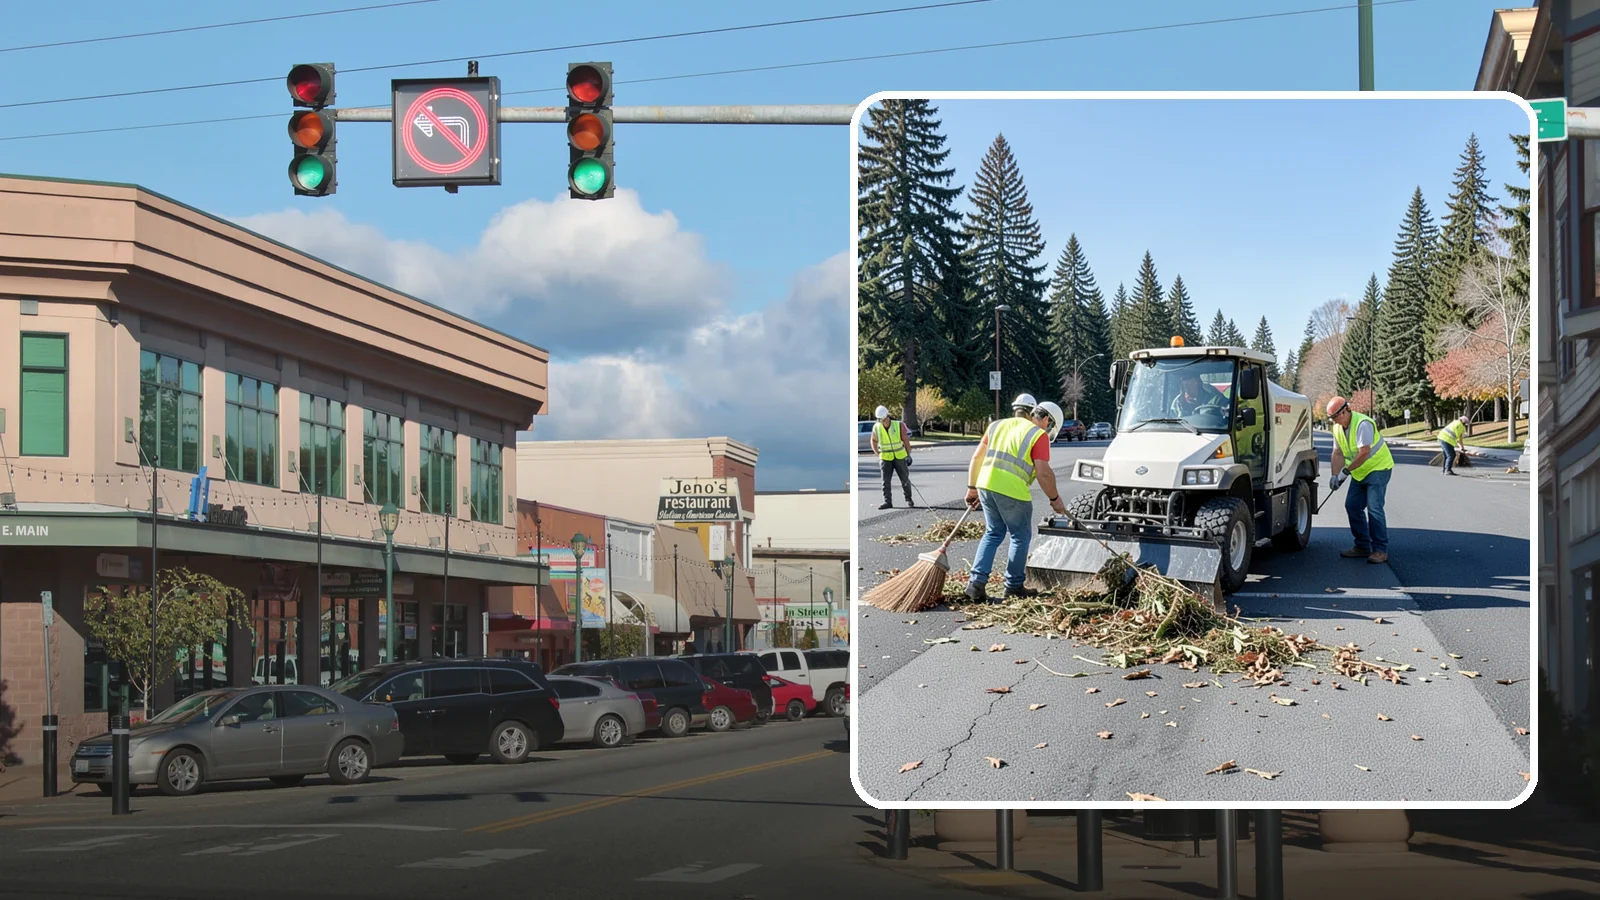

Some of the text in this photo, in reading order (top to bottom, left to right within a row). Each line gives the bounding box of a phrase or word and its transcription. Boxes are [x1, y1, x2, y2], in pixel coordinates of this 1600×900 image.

[670, 480, 727, 494] Jeno's
[665, 496, 731, 509] restaurant
[658, 510, 682, 519] Italian
[686, 509, 714, 519] American
[715, 509, 737, 519] Cuisine
[2, 525, 49, 536] E. MAIN
[797, 607, 829, 617] Street
